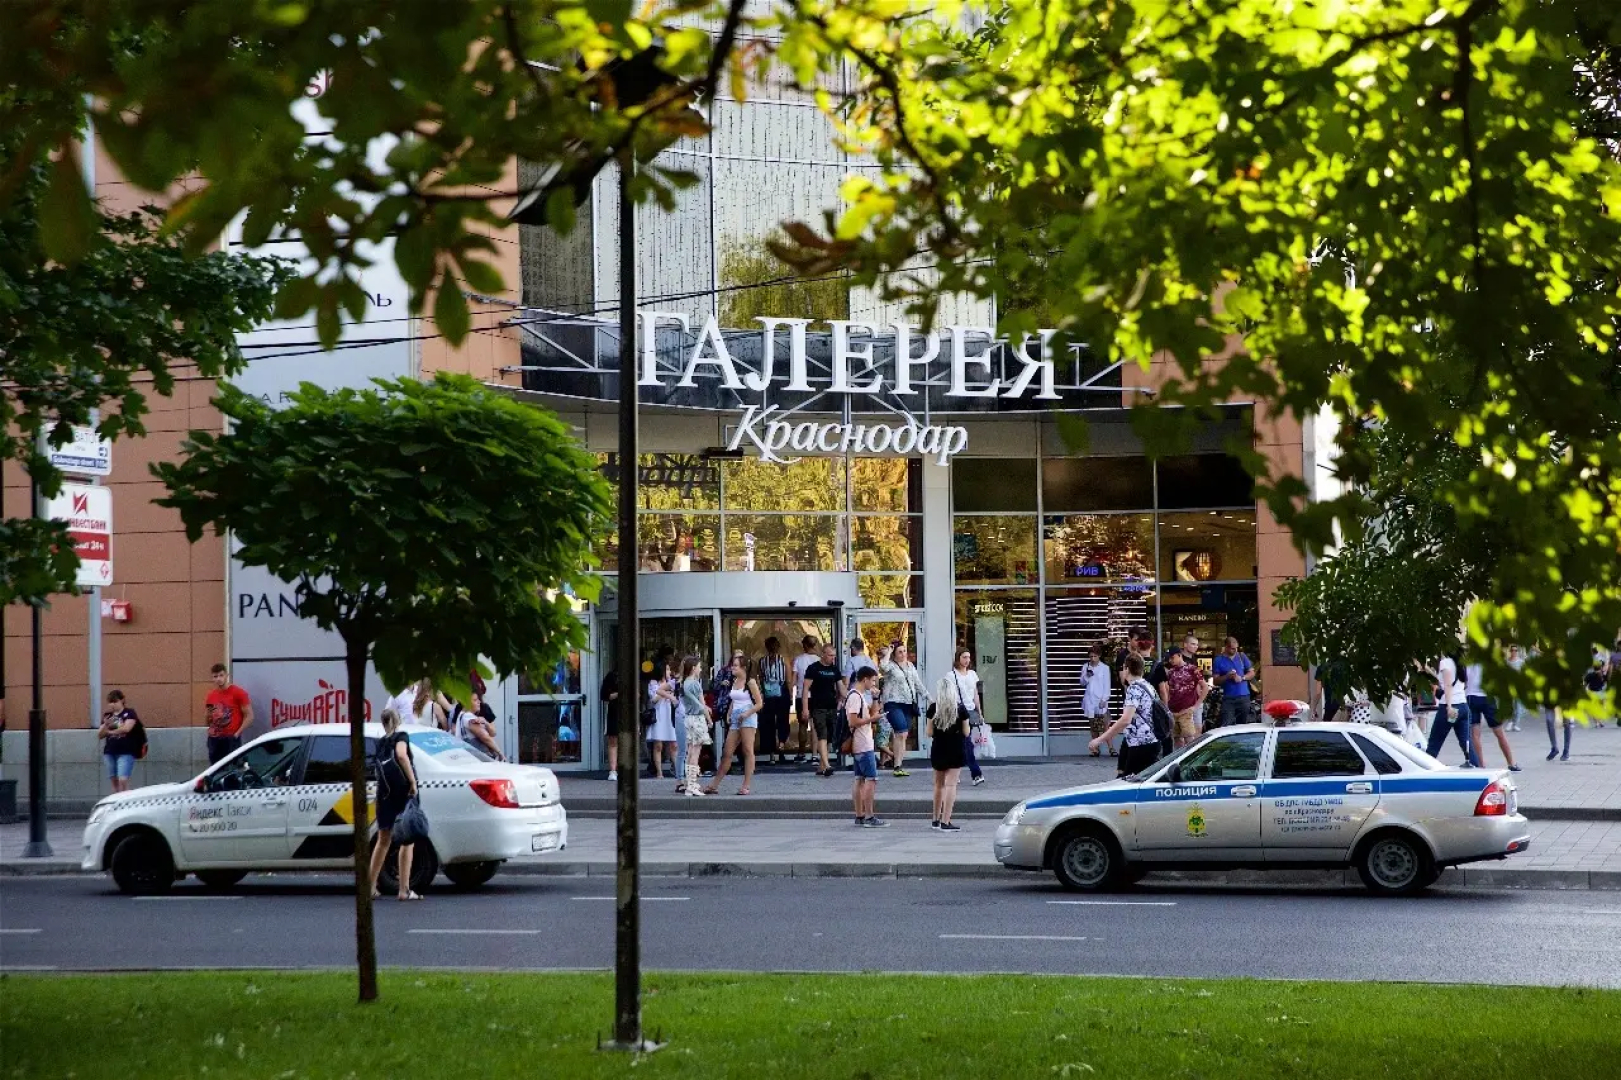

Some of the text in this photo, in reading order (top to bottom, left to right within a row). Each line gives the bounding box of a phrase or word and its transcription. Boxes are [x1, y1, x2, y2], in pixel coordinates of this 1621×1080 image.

[638, 311, 1064, 400] ГАЛЕРЕЯ
[727, 403, 968, 467] Краснодар
[238, 593, 300, 618] PAN
[1155, 785, 1217, 797] ПОЛИЦИЯ
[188, 803, 252, 820] Яндекс Такси
